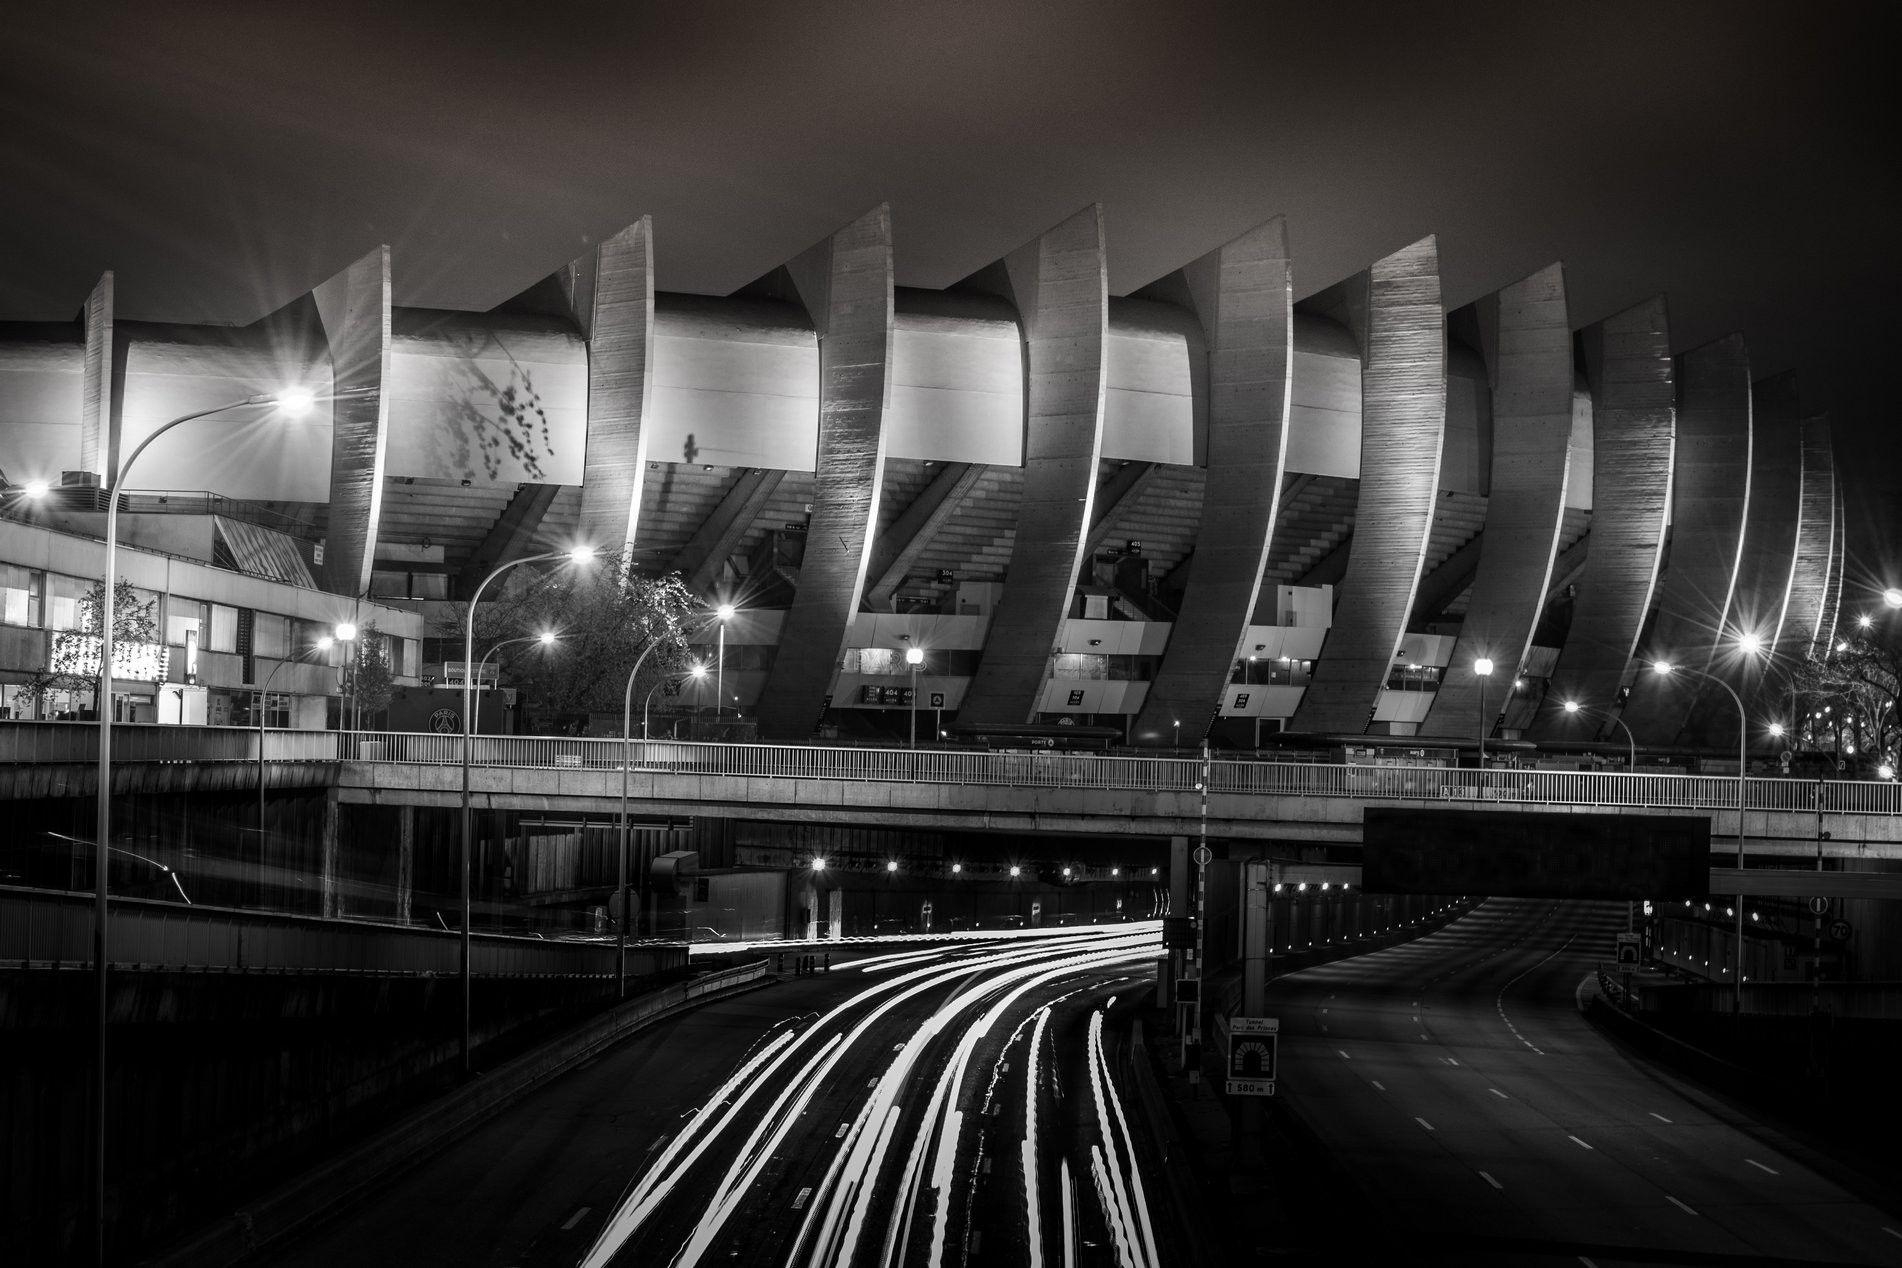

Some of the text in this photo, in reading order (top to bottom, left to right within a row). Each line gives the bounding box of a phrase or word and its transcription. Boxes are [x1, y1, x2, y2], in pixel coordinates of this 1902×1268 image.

[434, 709, 456, 719] PARIS
[1834, 925, 1848, 937] 70
[1237, 1083, 1255, 1092] 580
